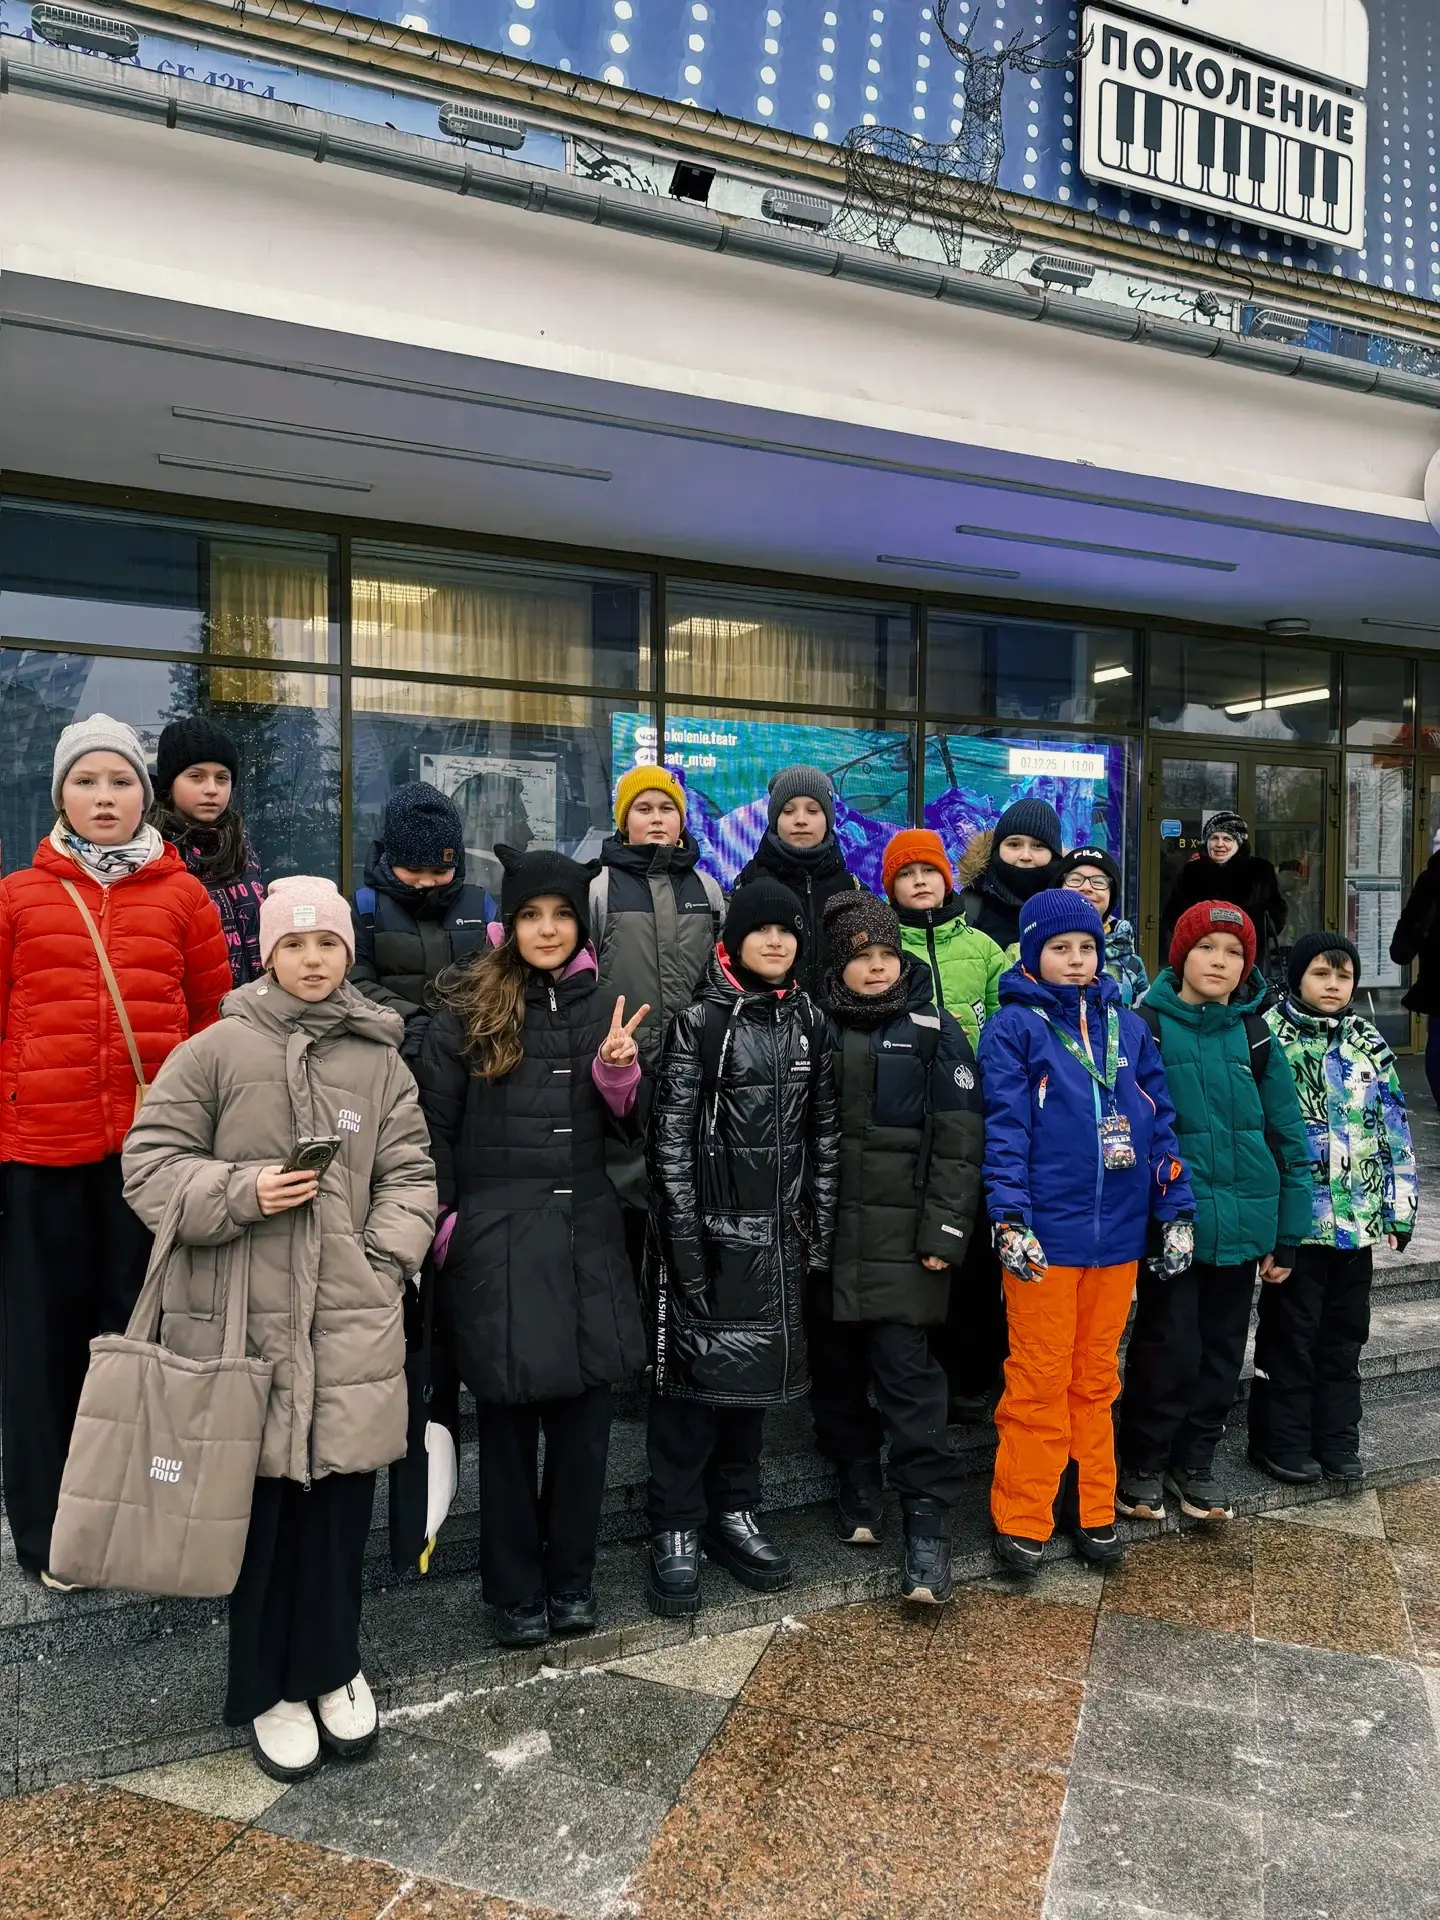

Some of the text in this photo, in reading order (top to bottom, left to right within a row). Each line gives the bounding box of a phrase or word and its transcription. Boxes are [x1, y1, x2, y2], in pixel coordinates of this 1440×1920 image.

[1102, 24, 1354, 144] ПОКОЛЕНИЕ
[664, 728, 738, 746] okolenie.teatr
[664, 752, 716, 768] eatr_mtch
[1020, 757, 1057, 770] 07.12.25
[1073, 849, 1103, 859] FILA
